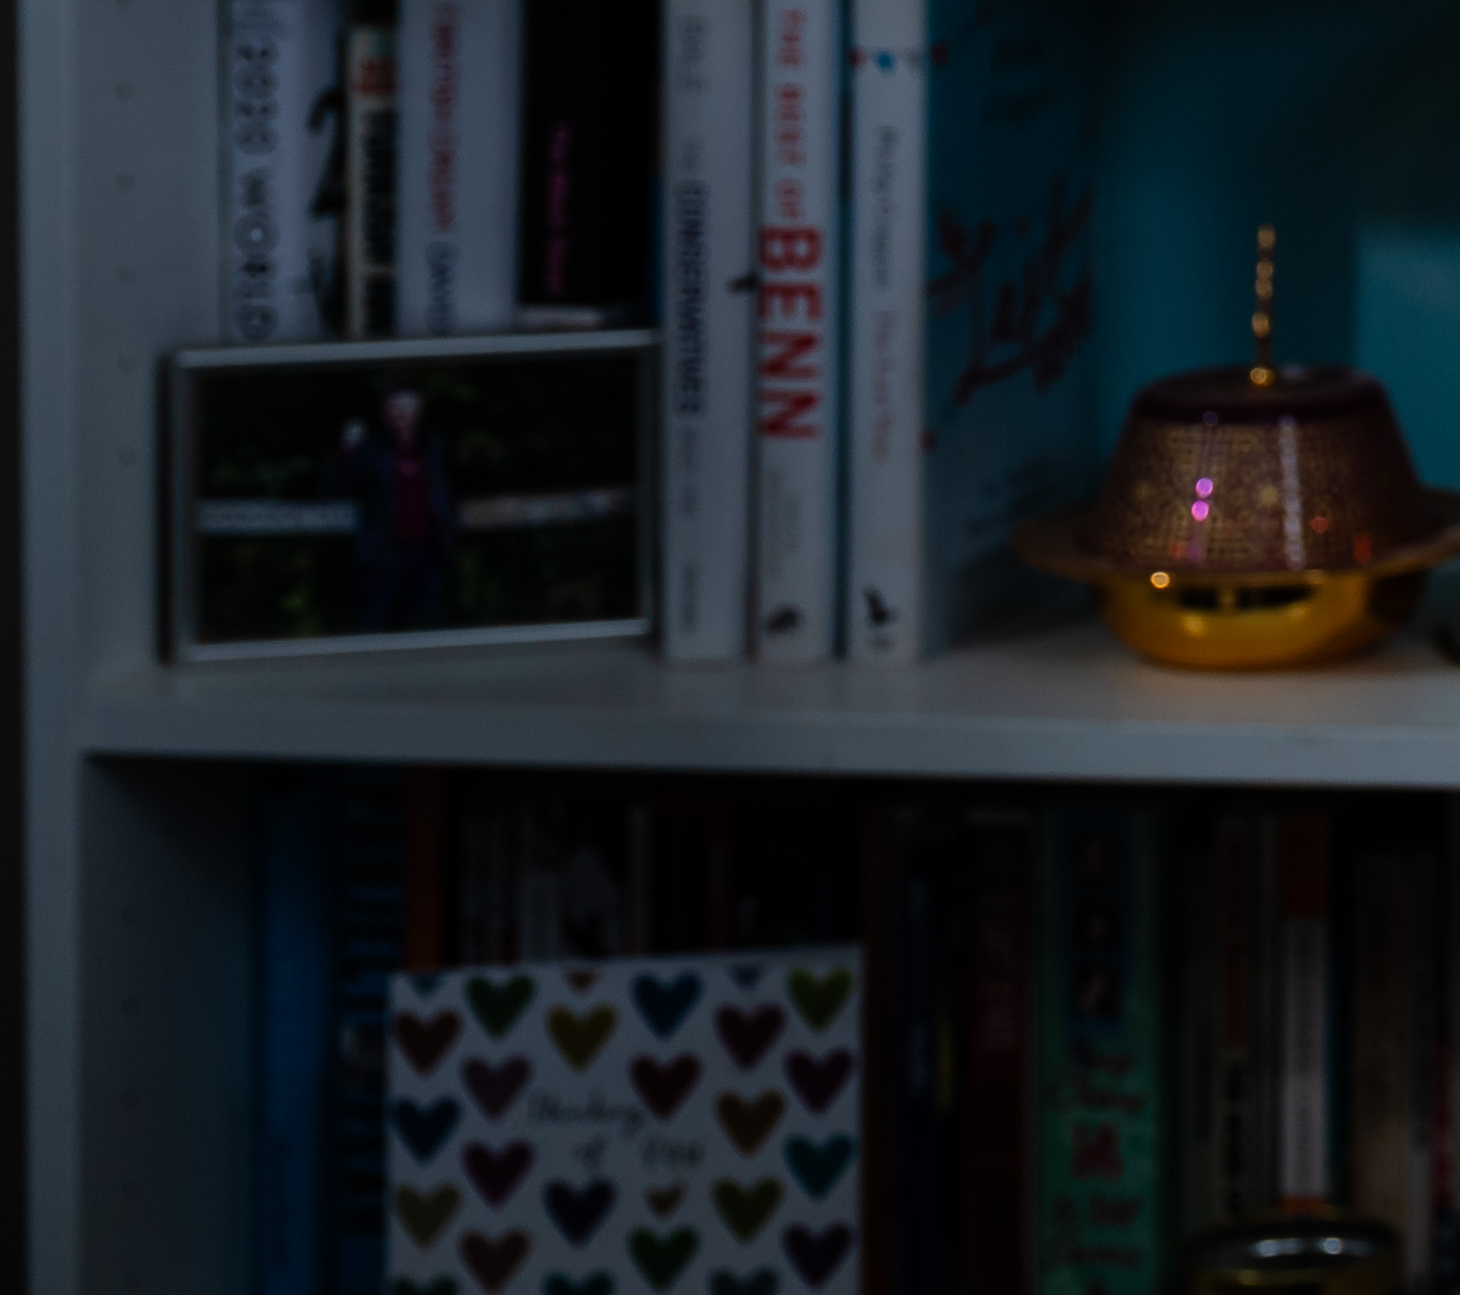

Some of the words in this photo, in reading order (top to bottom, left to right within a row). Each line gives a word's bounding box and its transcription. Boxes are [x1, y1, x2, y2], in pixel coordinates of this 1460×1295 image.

[779, 10, 809, 70] THE
[234, 37, 280, 158] 2020
[777, 82, 809, 168] BEST
[776, 179, 807, 223] OF
[676, 182, 709, 417] CONSERVATIVES
[755, 223, 823, 442] BENN
